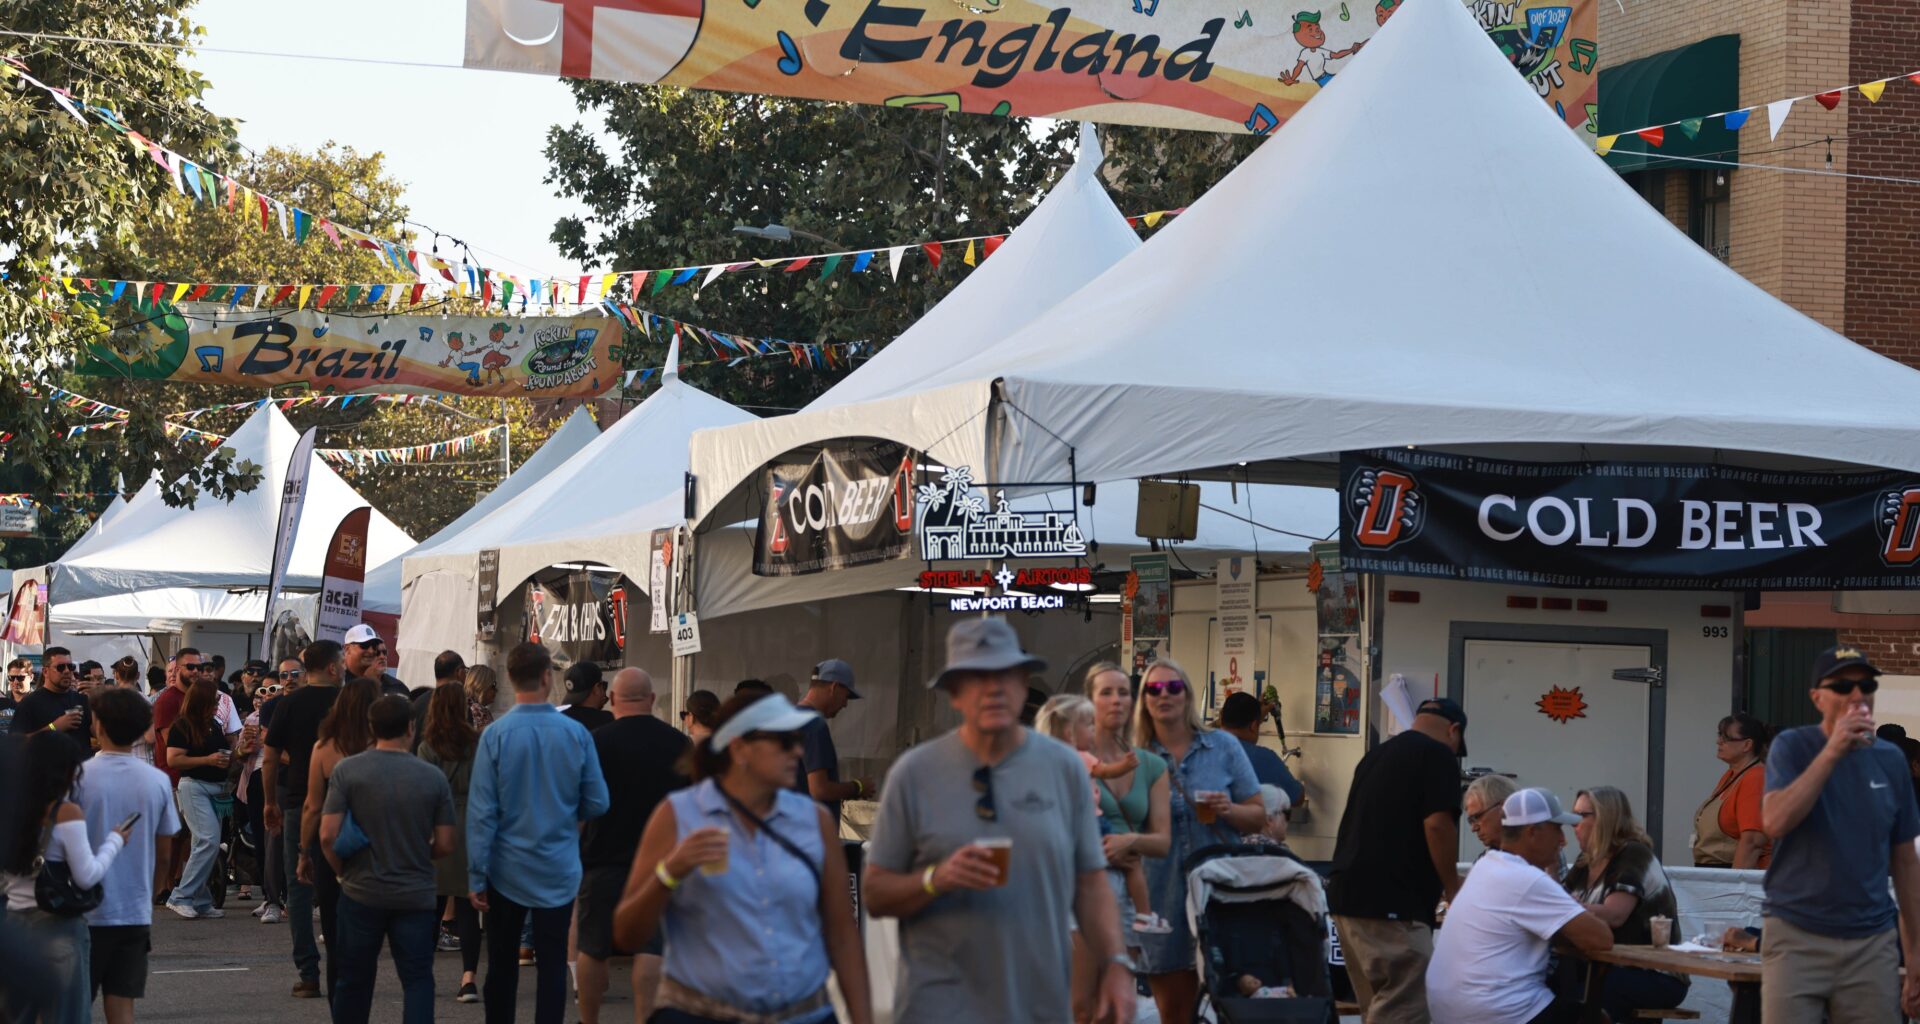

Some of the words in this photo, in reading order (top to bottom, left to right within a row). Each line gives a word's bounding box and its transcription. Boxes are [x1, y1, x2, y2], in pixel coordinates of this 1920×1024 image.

[1548, 8, 1567, 24] 2024
[804, 0, 1226, 88] England
[232, 317, 407, 379] Brazil
[523, 356, 598, 391] ROUNDABOUT
[534, 360, 562, 373] Round
[1386, 450, 1411, 464] HIGH
[1413, 454, 1464, 471] BASEBALL
[1476, 461, 1514, 477] ORANGE
[1516, 465, 1539, 477] HIGH
[1595, 465, 1635, 478] ORANGE
[1637, 466, 1661, 478] HIGH
[1663, 466, 1710, 479] BASEBALL
[1720, 468, 1759, 483] ORANGE
[1761, 474, 1786, 485] HIGH
[838, 477, 890, 526] BEER
[1478, 494, 1657, 548] COLD
[1677, 500, 1828, 550] BEER
[919, 569, 995, 588] STELLA
[1016, 567, 1092, 585] ARTOIS
[1382, 560, 1405, 571] HIGH
[1408, 562, 1456, 576] BASEBALL
[1467, 566, 1504, 580] ORANGE
[1506, 569, 1530, 581] HIGH
[1532, 572, 1581, 585] BASEBALL
[1721, 577, 1759, 588] ORANGE
[1760, 577, 1784, 588] HIGH
[1785, 576, 1832, 588] BASEBALL
[1843, 576, 1878, 588] ORANGE
[1880, 576, 1902, 587] HIGH
[323, 604, 359, 617] REPUBLIC
[325, 588, 360, 609] acai
[951, 597, 1018, 611] NEWPORT
[1021, 596, 1064, 609] BEACH
[570, 603, 579, 642] &
[580, 601, 606, 642] CHIPS
[677, 626, 693, 641] 403
[1702, 626, 1729, 639] 993
